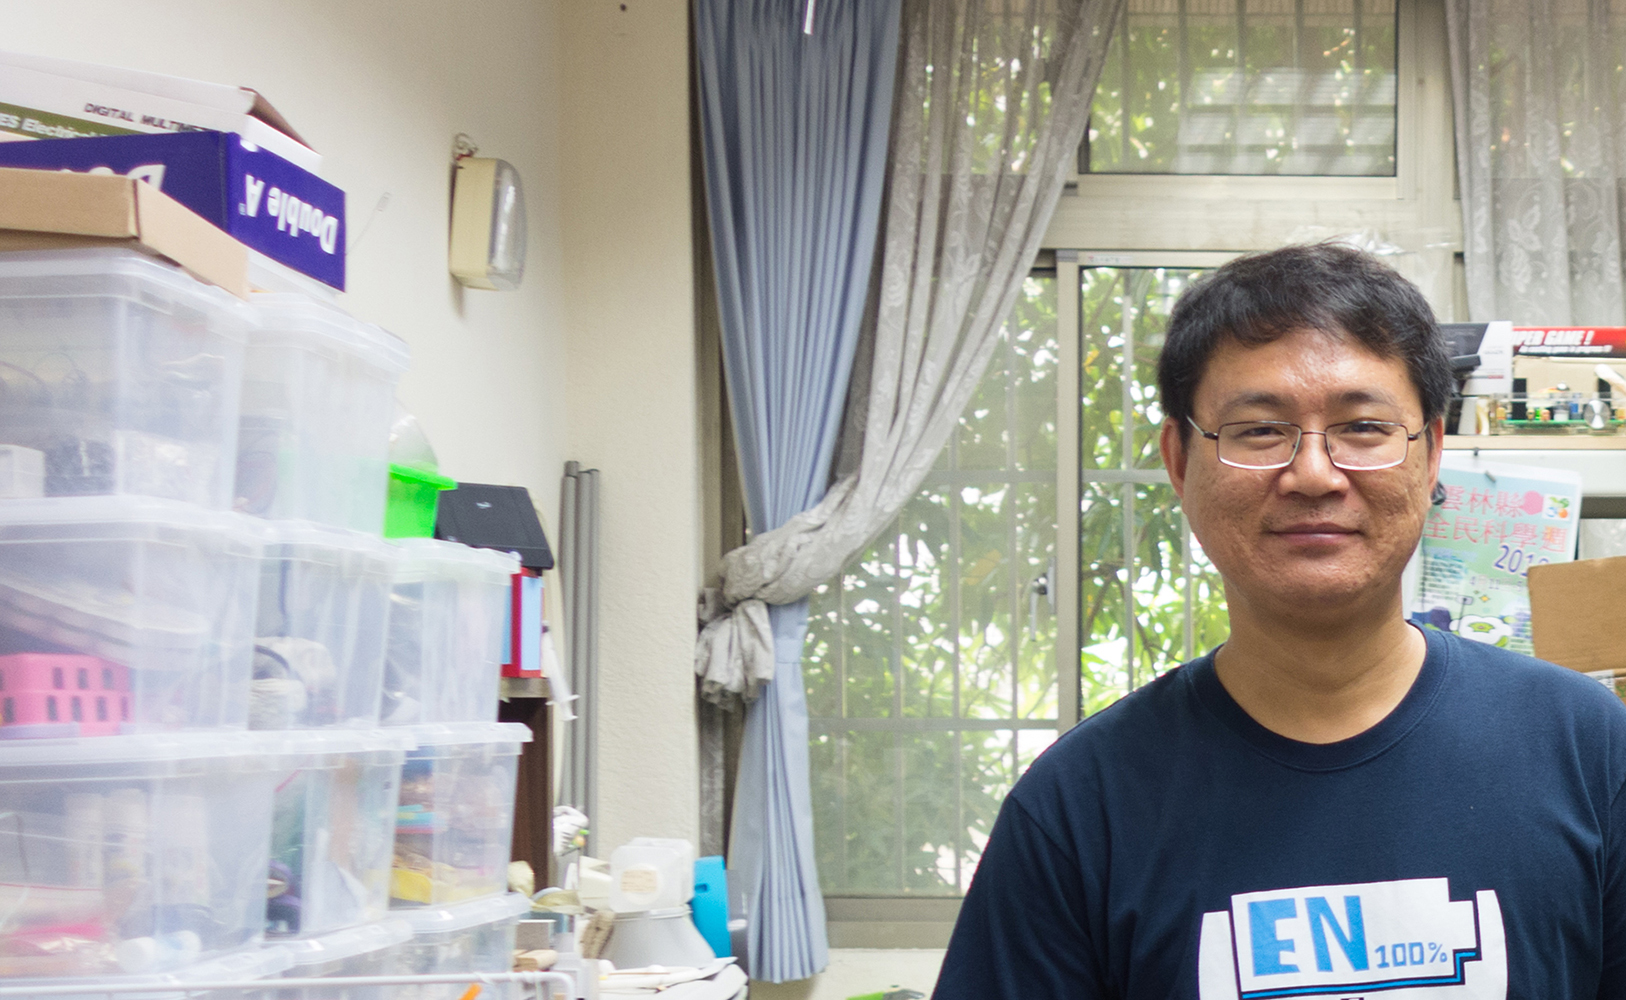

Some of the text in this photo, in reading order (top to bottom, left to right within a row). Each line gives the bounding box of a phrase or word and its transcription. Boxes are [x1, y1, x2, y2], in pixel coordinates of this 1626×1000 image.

[84, 102, 134, 122] DIGITAL
[245, 174, 339, 255] Double A
[1441, 484, 1525, 518] 雲林縣
[1425, 513, 1569, 553] 全民科學週
[1247, 895, 1449, 977] EN 100%
